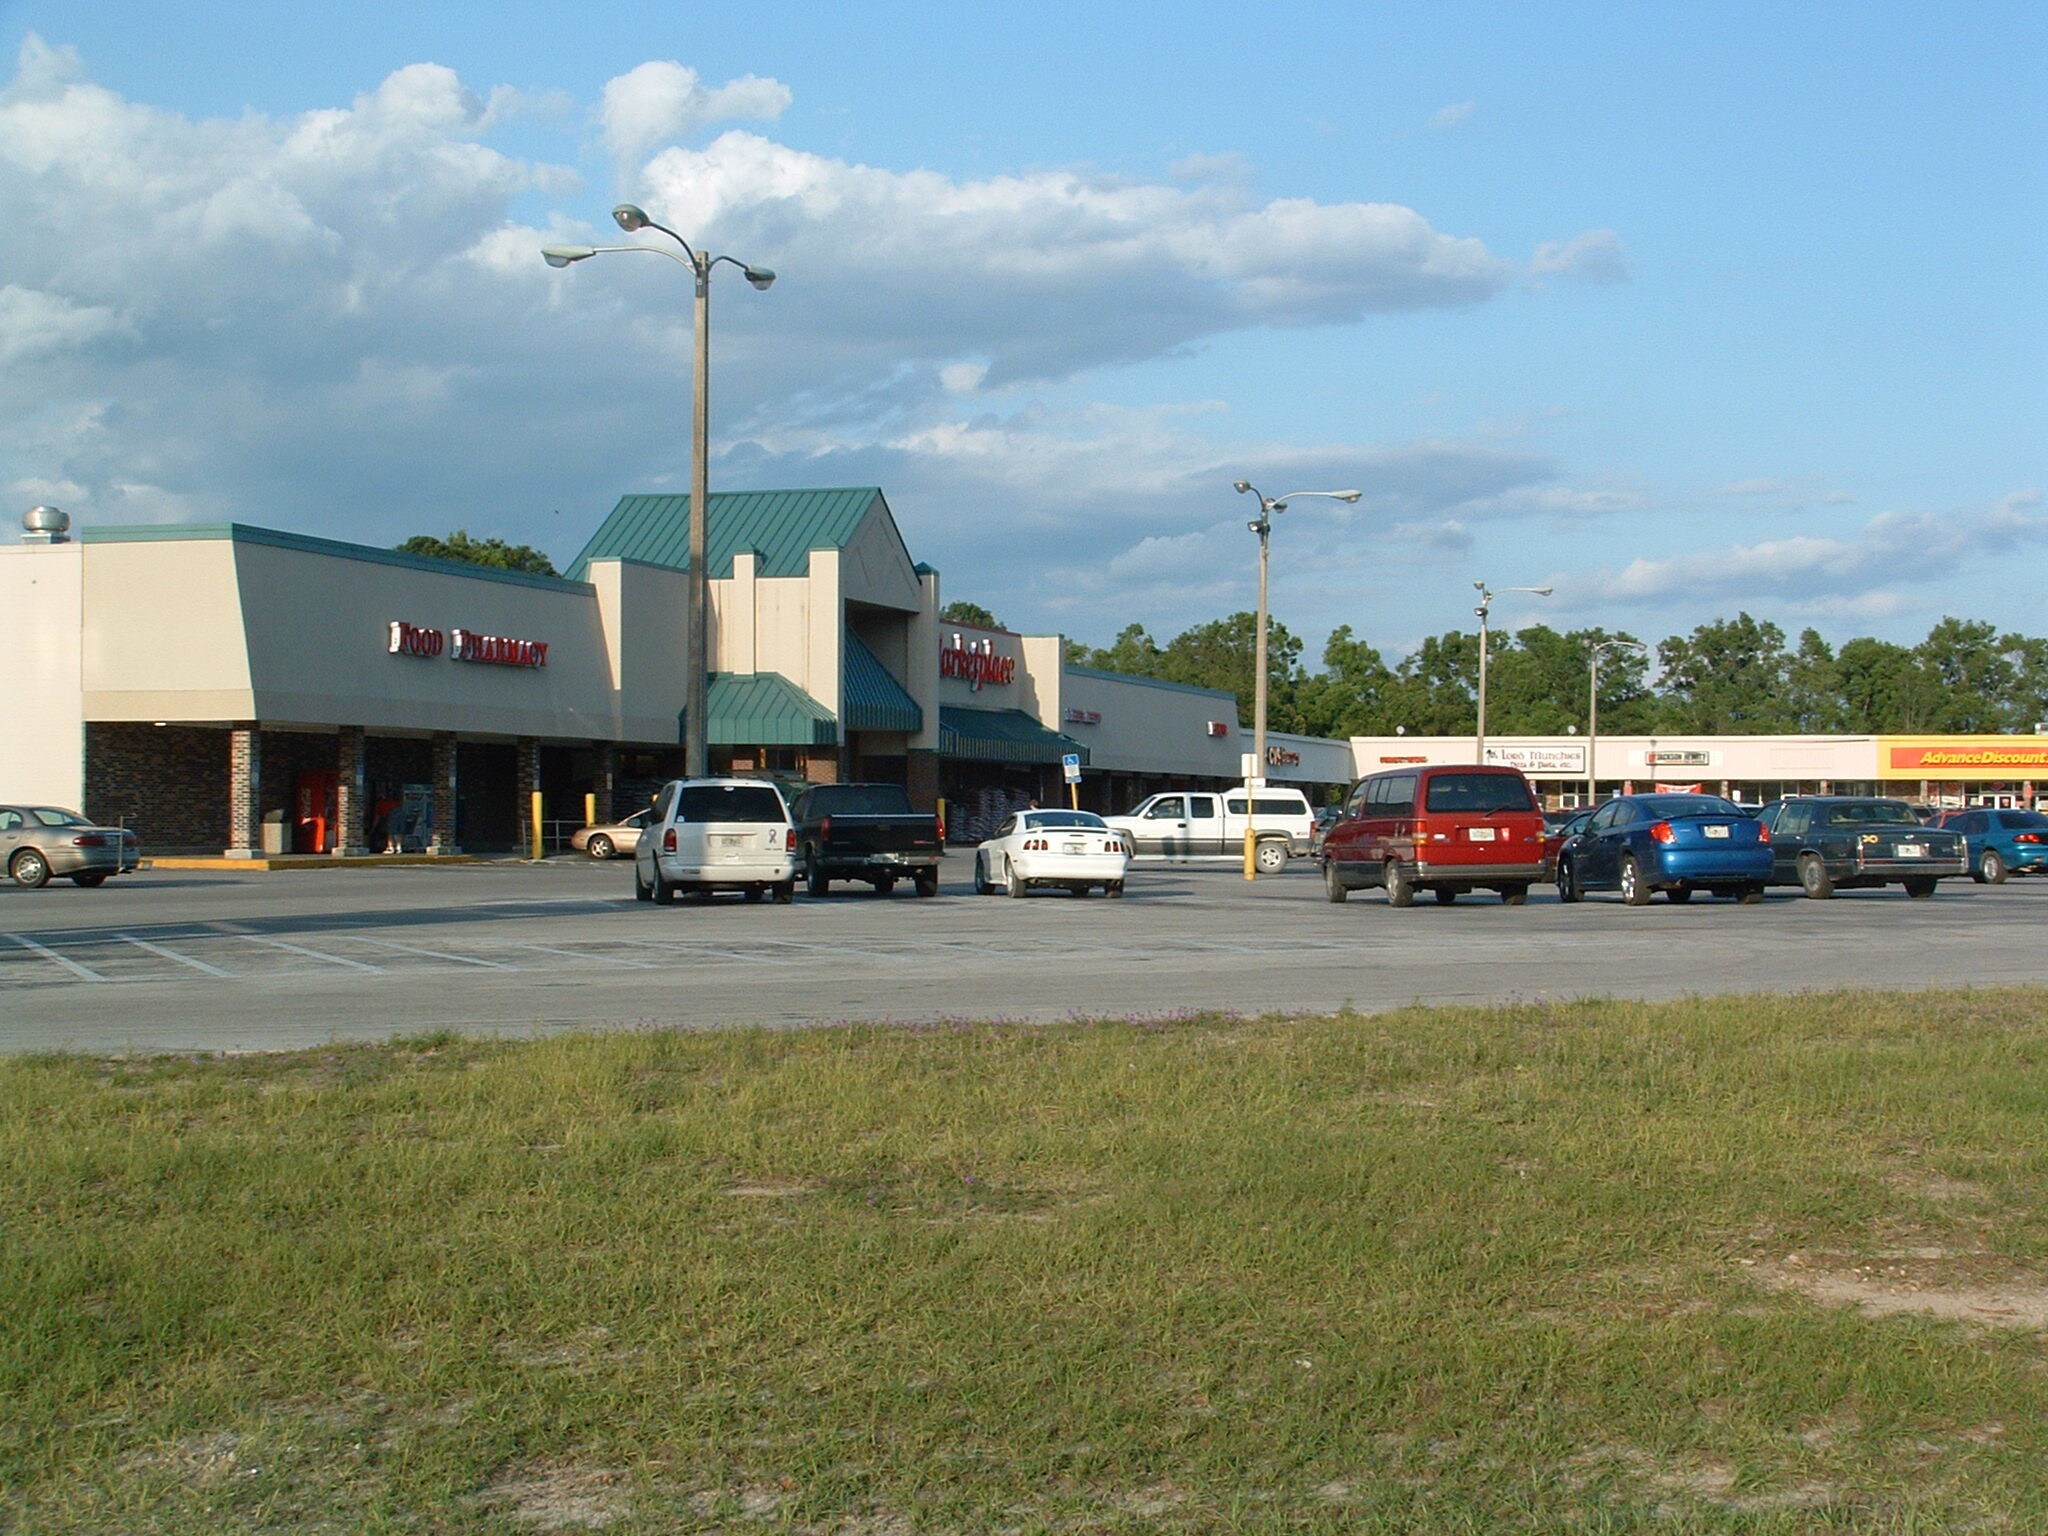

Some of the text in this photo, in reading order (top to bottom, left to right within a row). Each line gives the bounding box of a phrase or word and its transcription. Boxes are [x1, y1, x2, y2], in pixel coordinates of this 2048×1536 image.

[450, 629, 548, 668] PHARMACY
[939, 633, 1015, 692] arketplace
[1920, 751, 2048, 765] AdvanceDiscount
